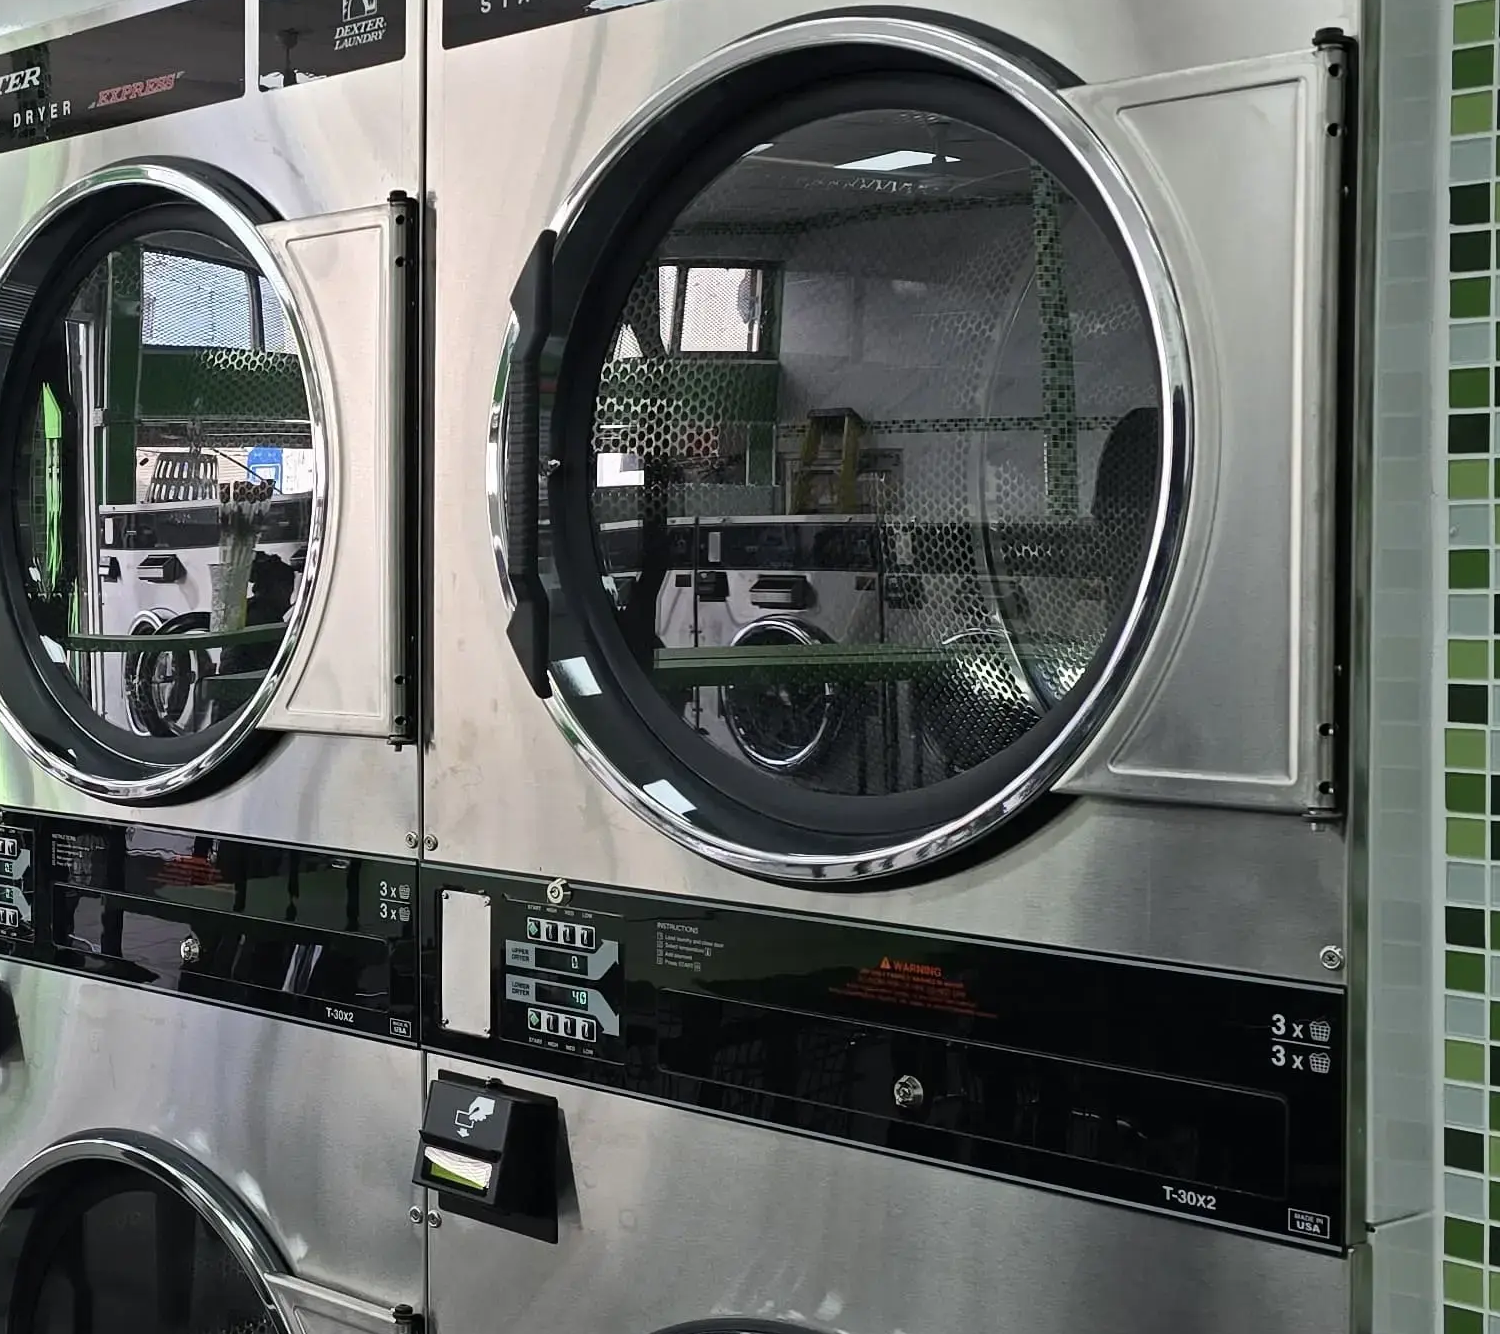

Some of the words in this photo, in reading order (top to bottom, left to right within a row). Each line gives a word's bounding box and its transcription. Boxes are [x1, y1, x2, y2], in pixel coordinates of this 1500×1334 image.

[334, 17, 385, 39] DEXTER
[334, 29, 386, 51] LAUNDRY
[96, 73, 177, 108] EXPRESS
[13, 100, 71, 128] DRYER
[379, 881, 387, 897] 3
[390, 887, 397, 898] x
[379, 903, 387, 918] 3
[390, 909, 397, 920] x
[657, 921, 699, 934] INSTRUCTIONS
[893, 960, 942, 977] WARNING
[326, 1007, 354, 1023] T-30X2
[1271, 1013, 1286, 1035] 3
[1292, 1023, 1304, 1039] x
[1271, 1045, 1286, 1067] 3
[1292, 1054, 1304, 1071] x
[1162, 1185, 1217, 1211] T-30X2
[1296, 1220, 1321, 1234] USA
